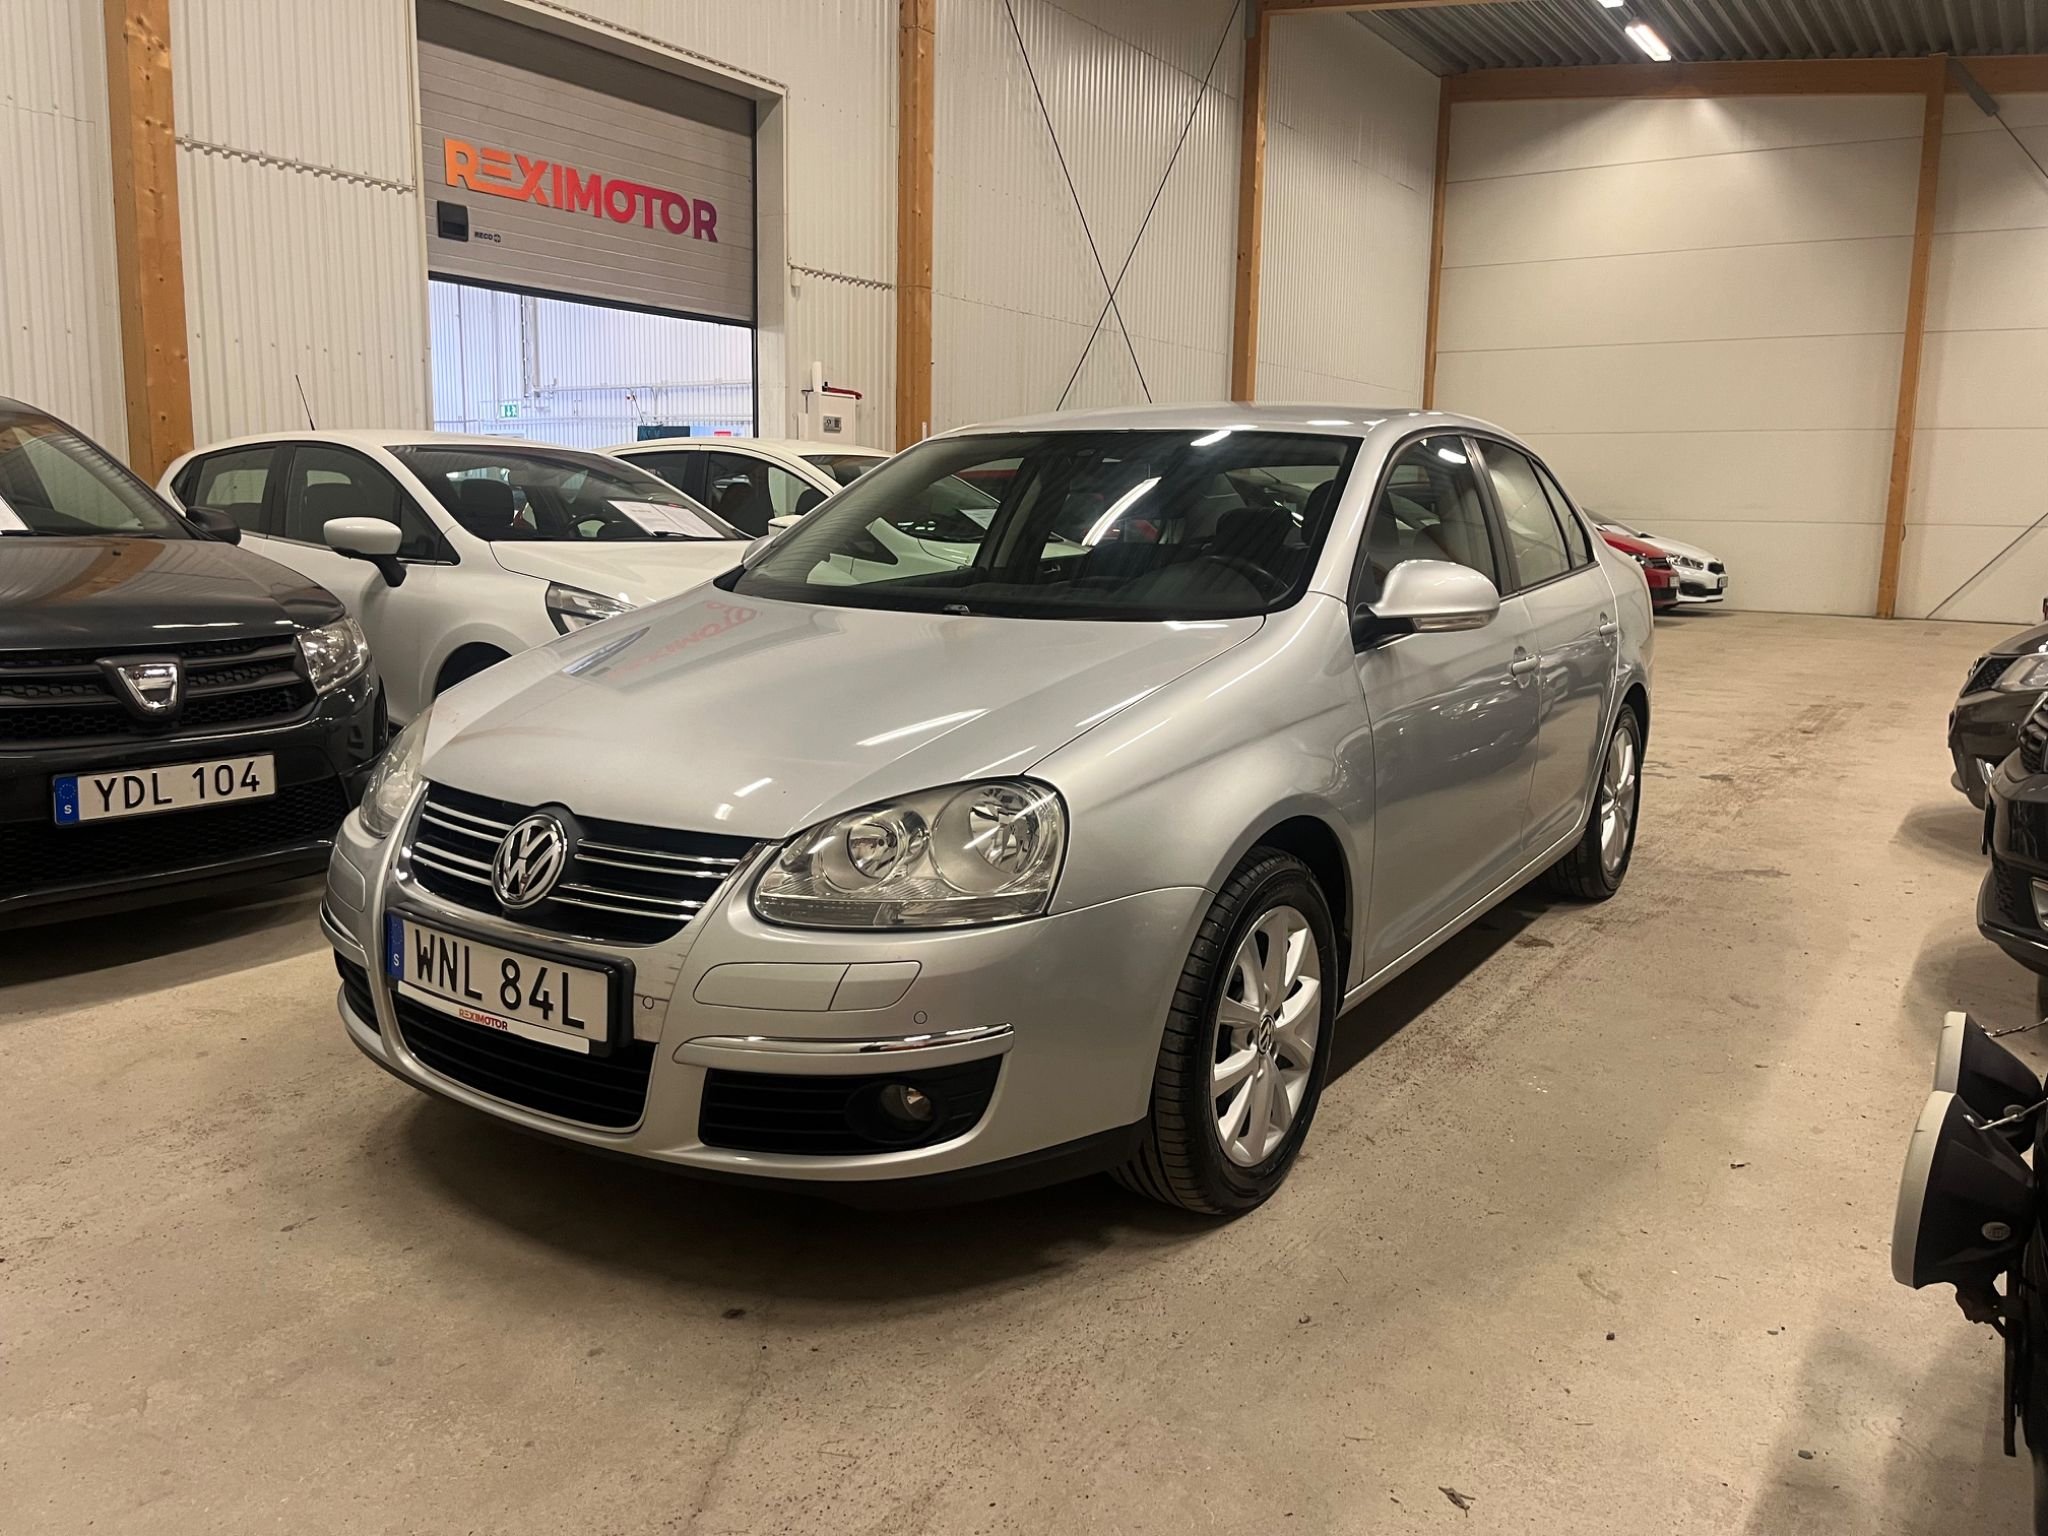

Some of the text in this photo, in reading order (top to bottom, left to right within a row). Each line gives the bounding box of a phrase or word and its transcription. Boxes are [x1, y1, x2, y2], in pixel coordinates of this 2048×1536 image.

[444, 136, 719, 243] REXIMOTOR
[93, 760, 261, 812] YDL 104
[64, 804, 73, 815] S
[393, 953, 400, 967] S
[415, 928, 585, 1031] WNL 84L
[458, 1008, 509, 1031] REXIMOTOR
